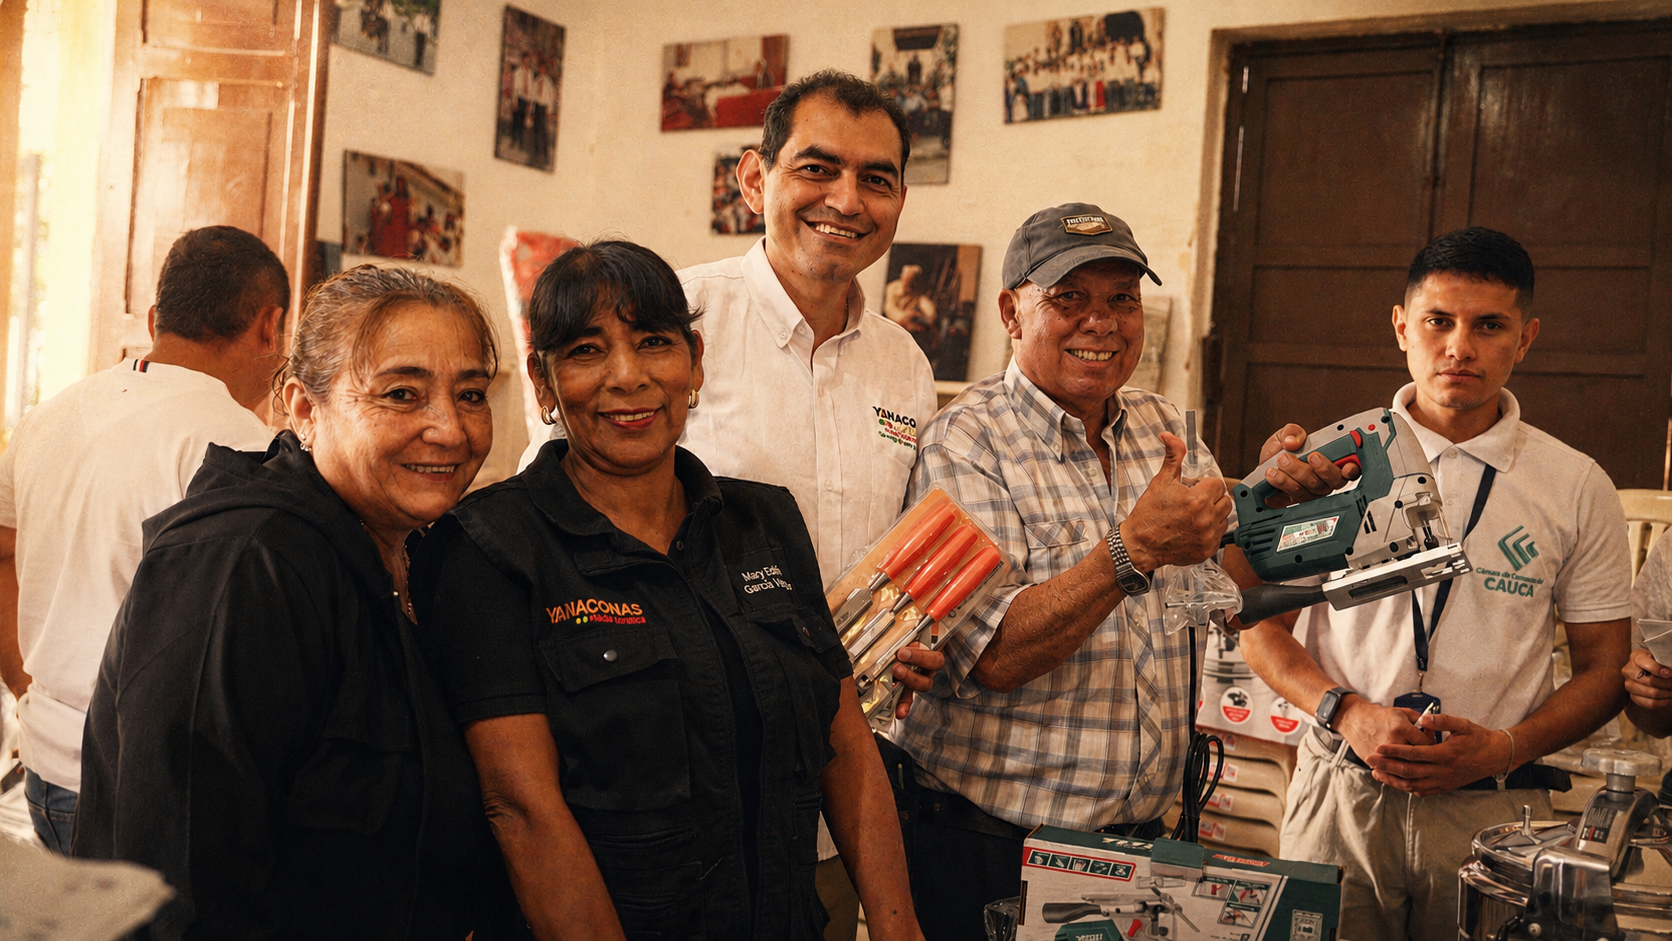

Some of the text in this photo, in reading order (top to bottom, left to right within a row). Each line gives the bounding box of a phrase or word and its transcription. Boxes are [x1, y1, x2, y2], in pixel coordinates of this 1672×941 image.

[741, 570, 765, 581] Mary
[1484, 577, 1534, 597] CAUCA
[546, 599, 643, 624] YANACONAS
